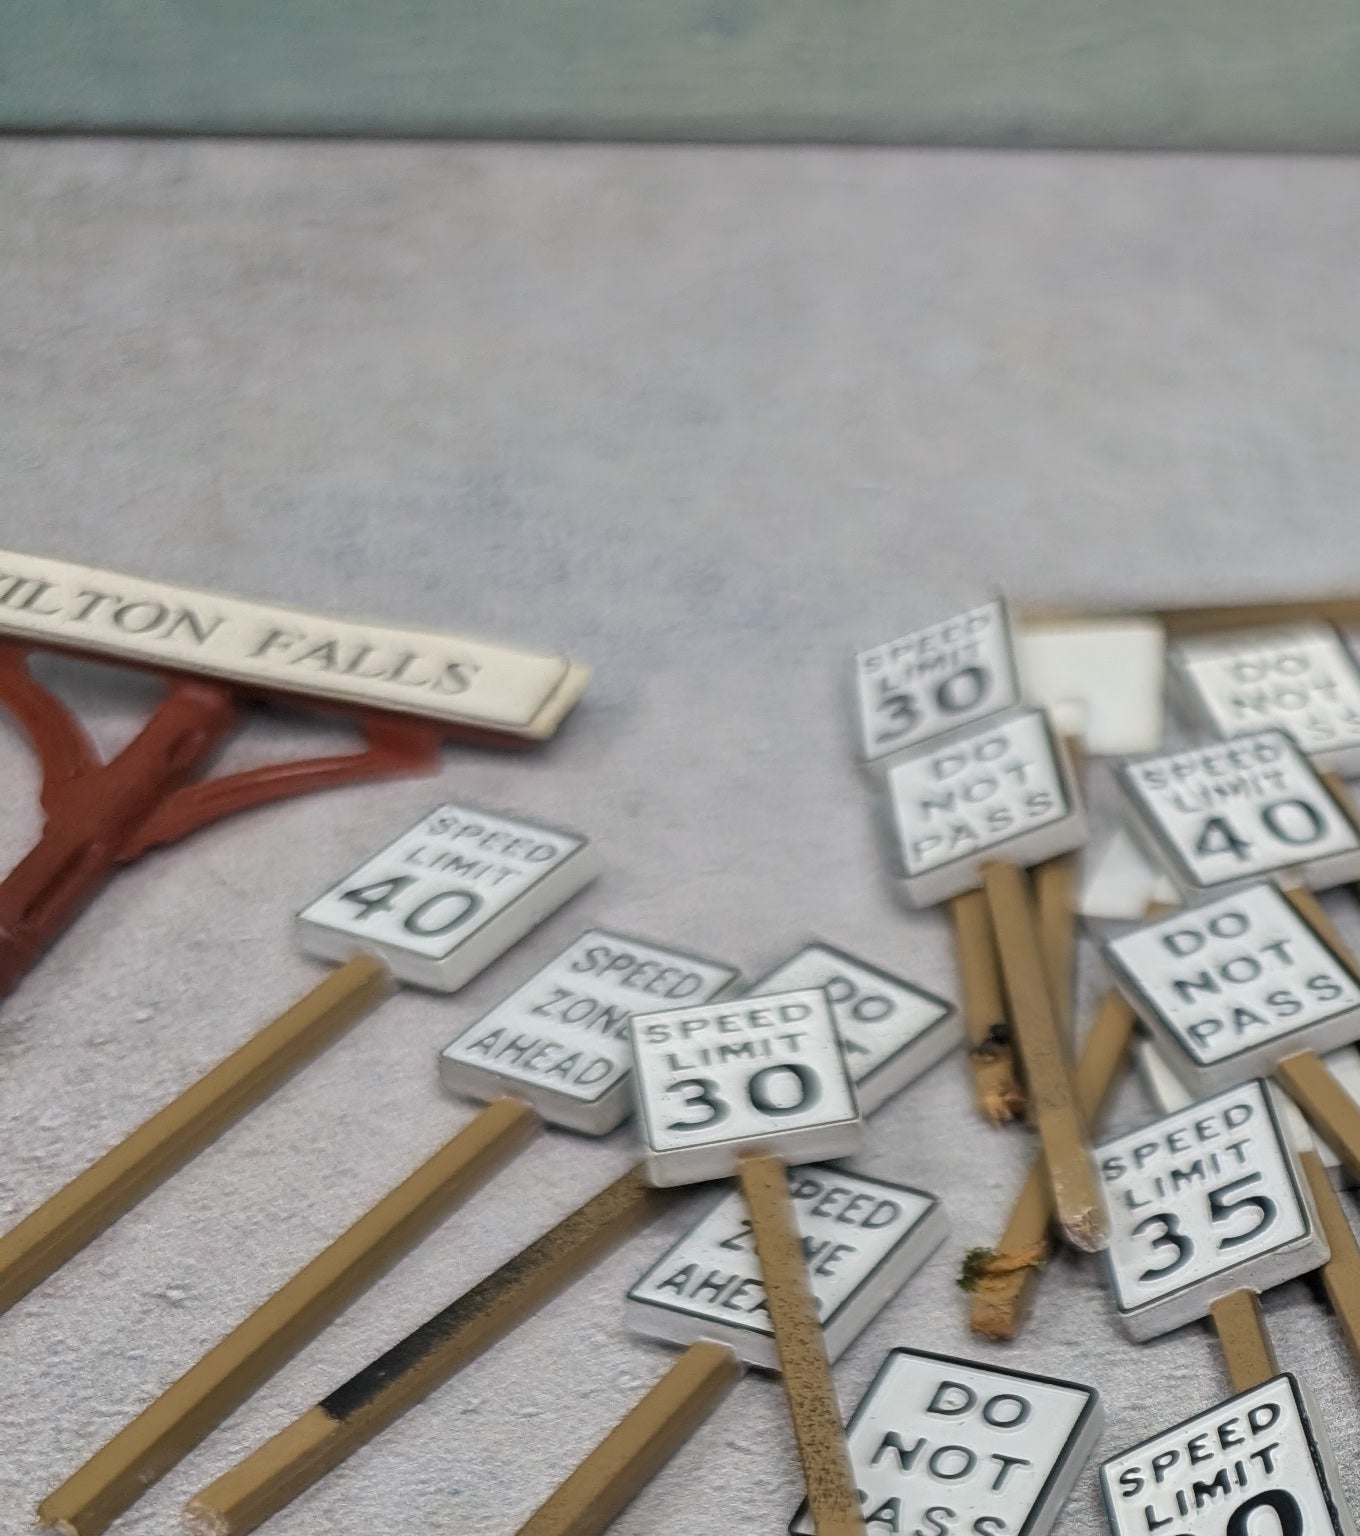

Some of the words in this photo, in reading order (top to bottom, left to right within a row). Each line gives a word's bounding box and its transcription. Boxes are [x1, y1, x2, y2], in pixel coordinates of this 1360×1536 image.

[0, 574, 225, 646] ILTON
[248, 628, 482, 697] FALLS
[863, 611, 990, 674] SPEED
[882, 643, 980, 693] LIMIT
[1232, 656, 1310, 683] DO
[875, 666, 989, 746] 30
[921, 760, 1035, 815] NOT
[933, 738, 1009, 781] DO
[1142, 743, 1282, 790] SPEED
[1174, 774, 1289, 812] LIMIT
[424, 812, 558, 864] SPEED
[913, 793, 1053, 862] PASS
[1197, 800, 1326, 862] 40
[405, 843, 522, 887] LIMIT
[338, 873, 484, 938] 40
[1162, 912, 1249, 958] DO
[571, 946, 704, 999] SPEED
[1172, 939, 1294, 1004] NOT
[647, 1003, 811, 1045] SPEED
[1187, 974, 1342, 1048] PASS
[466, 1028, 615, 1086] AHEAD
[667, 1033, 808, 1073] LIMIT
[665, 1063, 823, 1132] 30
[1102, 1104, 1254, 1181] SPEED
[788, 1169, 901, 1229] PEED
[1126, 1138, 1251, 1209] LIMIT
[1131, 1171, 1278, 1282] 35
[927, 1380, 1032, 1428] DO
[871, 1431, 1031, 1491] NOT
[1119, 1403, 1281, 1498] SPEED
[1144, 1442, 1280, 1532] LIMIT
